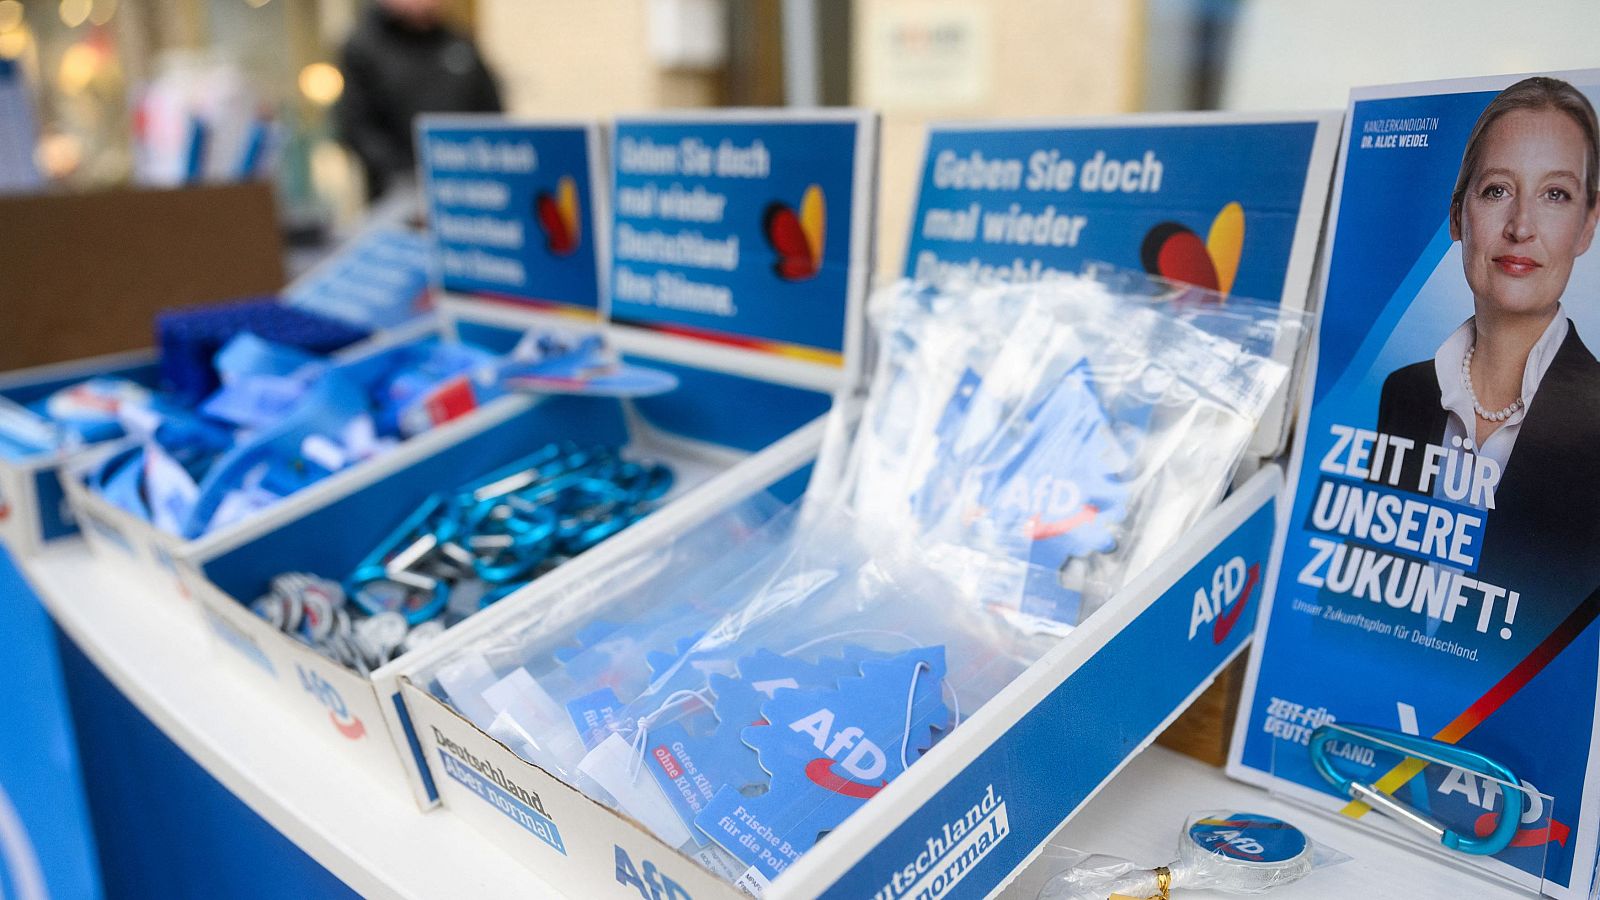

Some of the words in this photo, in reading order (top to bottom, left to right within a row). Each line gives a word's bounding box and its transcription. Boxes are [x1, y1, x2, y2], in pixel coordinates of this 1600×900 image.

[1361, 135, 1373, 149] DR.
[1375, 135, 1397, 149] ALICE
[1399, 134, 1429, 148] WEIDEL
[1363, 118, 1439, 133] KANZLERKANDIDATIN
[618, 137, 677, 175] Geben
[680, 137, 712, 177] Sie
[716, 138, 771, 179] doch
[933, 149, 1022, 191] Geben
[1026, 149, 1075, 193] Sie
[1080, 150, 1163, 194] doch
[659, 181, 727, 224] wieder
[923, 201, 981, 242] mal
[983, 203, 1087, 248] wieder
[1319, 424, 1415, 486] ZEIT
[1418, 435, 1501, 509] FÜR
[1002, 475, 1080, 514] AfD
[1312, 481, 1482, 567] UNSERE
[1188, 556, 1246, 640] AfD
[1297, 537, 1521, 640] ZUKUNFT!
[1292, 599, 1321, 617] Unser
[1323, 605, 1392, 635] Zukunftsplan
[1393, 625, 1410, 640] für
[1411, 630, 1479, 662] Deutschland.
[1266, 697, 1304, 722] ZEIT
[655, 749, 679, 777] ohne
[671, 742, 697, 775] Gutes
[788, 708, 887, 780] AfD
[1263, 715, 1376, 768] DEUTSLAND.
[430, 724, 553, 820] Deutschland.
[444, 755, 485, 796] Aber
[485, 786, 563, 851] normal.
[717, 816, 740, 837] für
[738, 833, 761, 854] die
[758, 847, 789, 874] Poli
[733, 805, 781, 847] Frische
[778, 840, 804, 865] Bri
[866, 783, 1002, 900] utschland.
[1213, 829, 1265, 855] AfD
